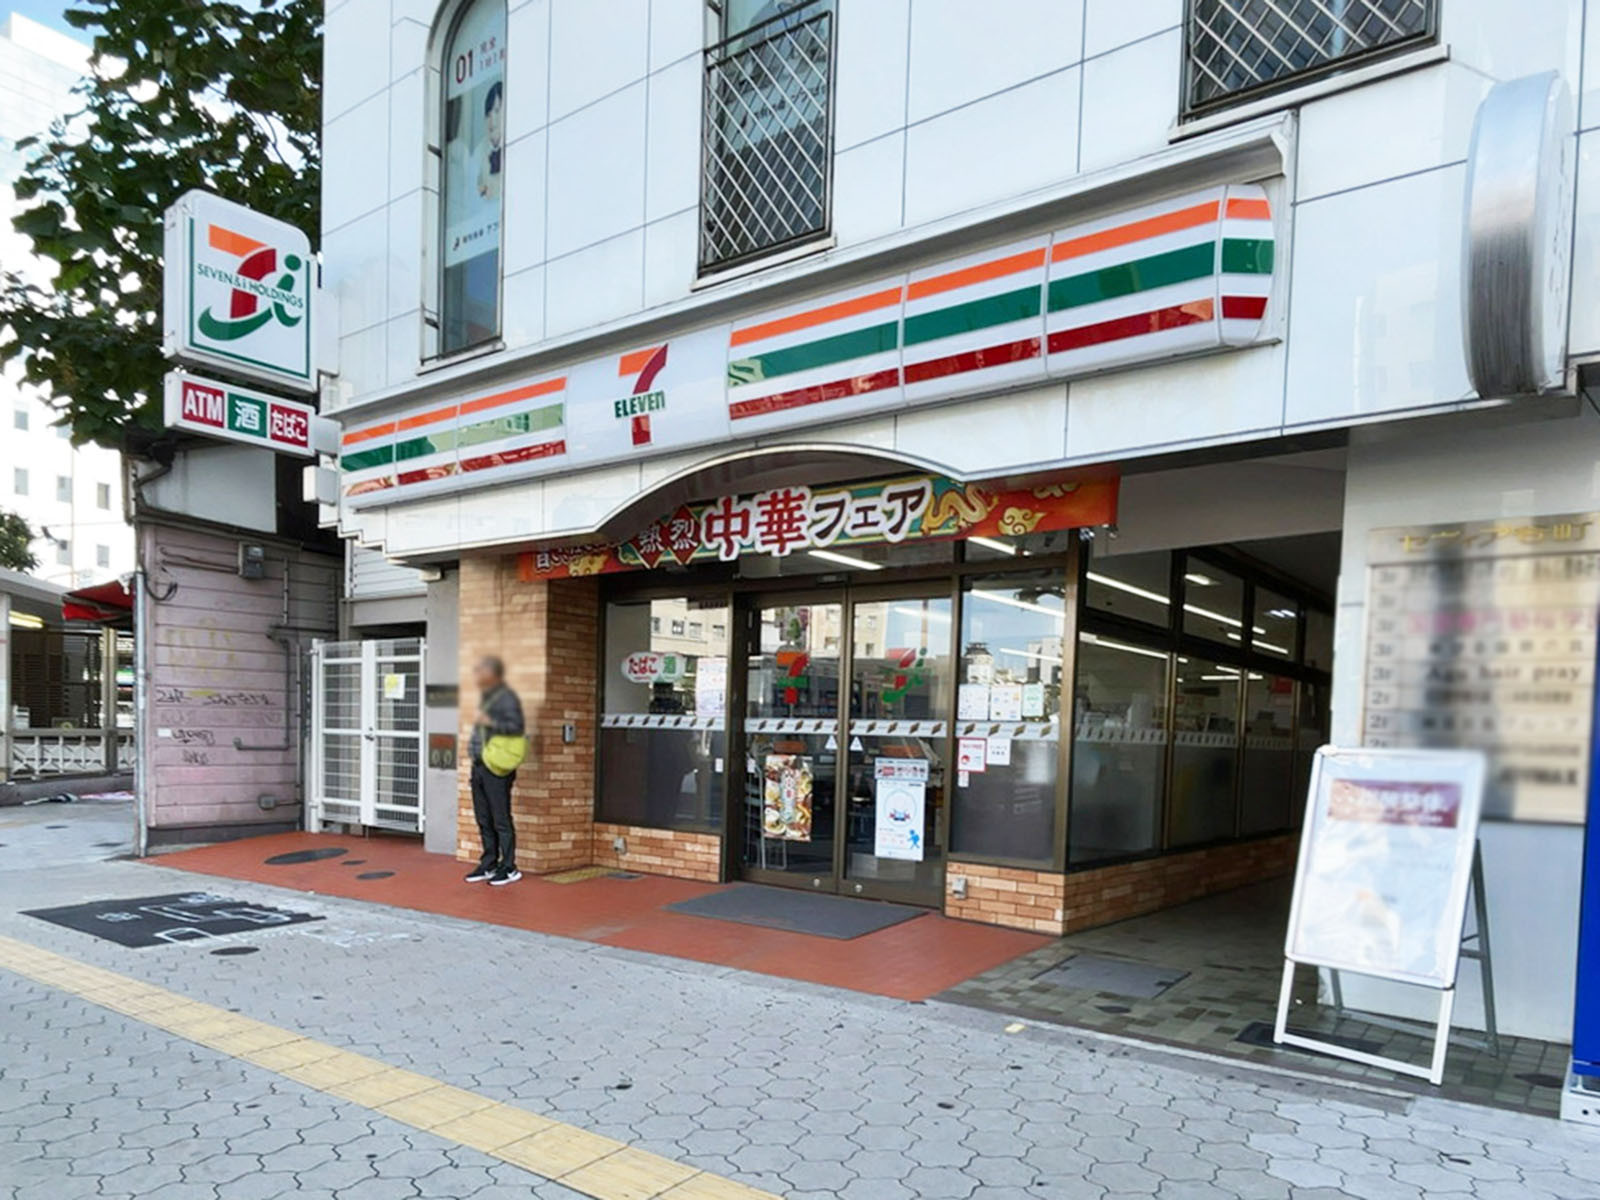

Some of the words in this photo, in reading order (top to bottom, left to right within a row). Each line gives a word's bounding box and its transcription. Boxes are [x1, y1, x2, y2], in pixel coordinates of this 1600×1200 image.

[456, 49, 473, 84] 01
[248, 283, 304, 309] HOLDINGS
[184, 388, 223, 423] ATM
[234, 399, 261, 431] 酒
[271, 409, 307, 441] たばこ
